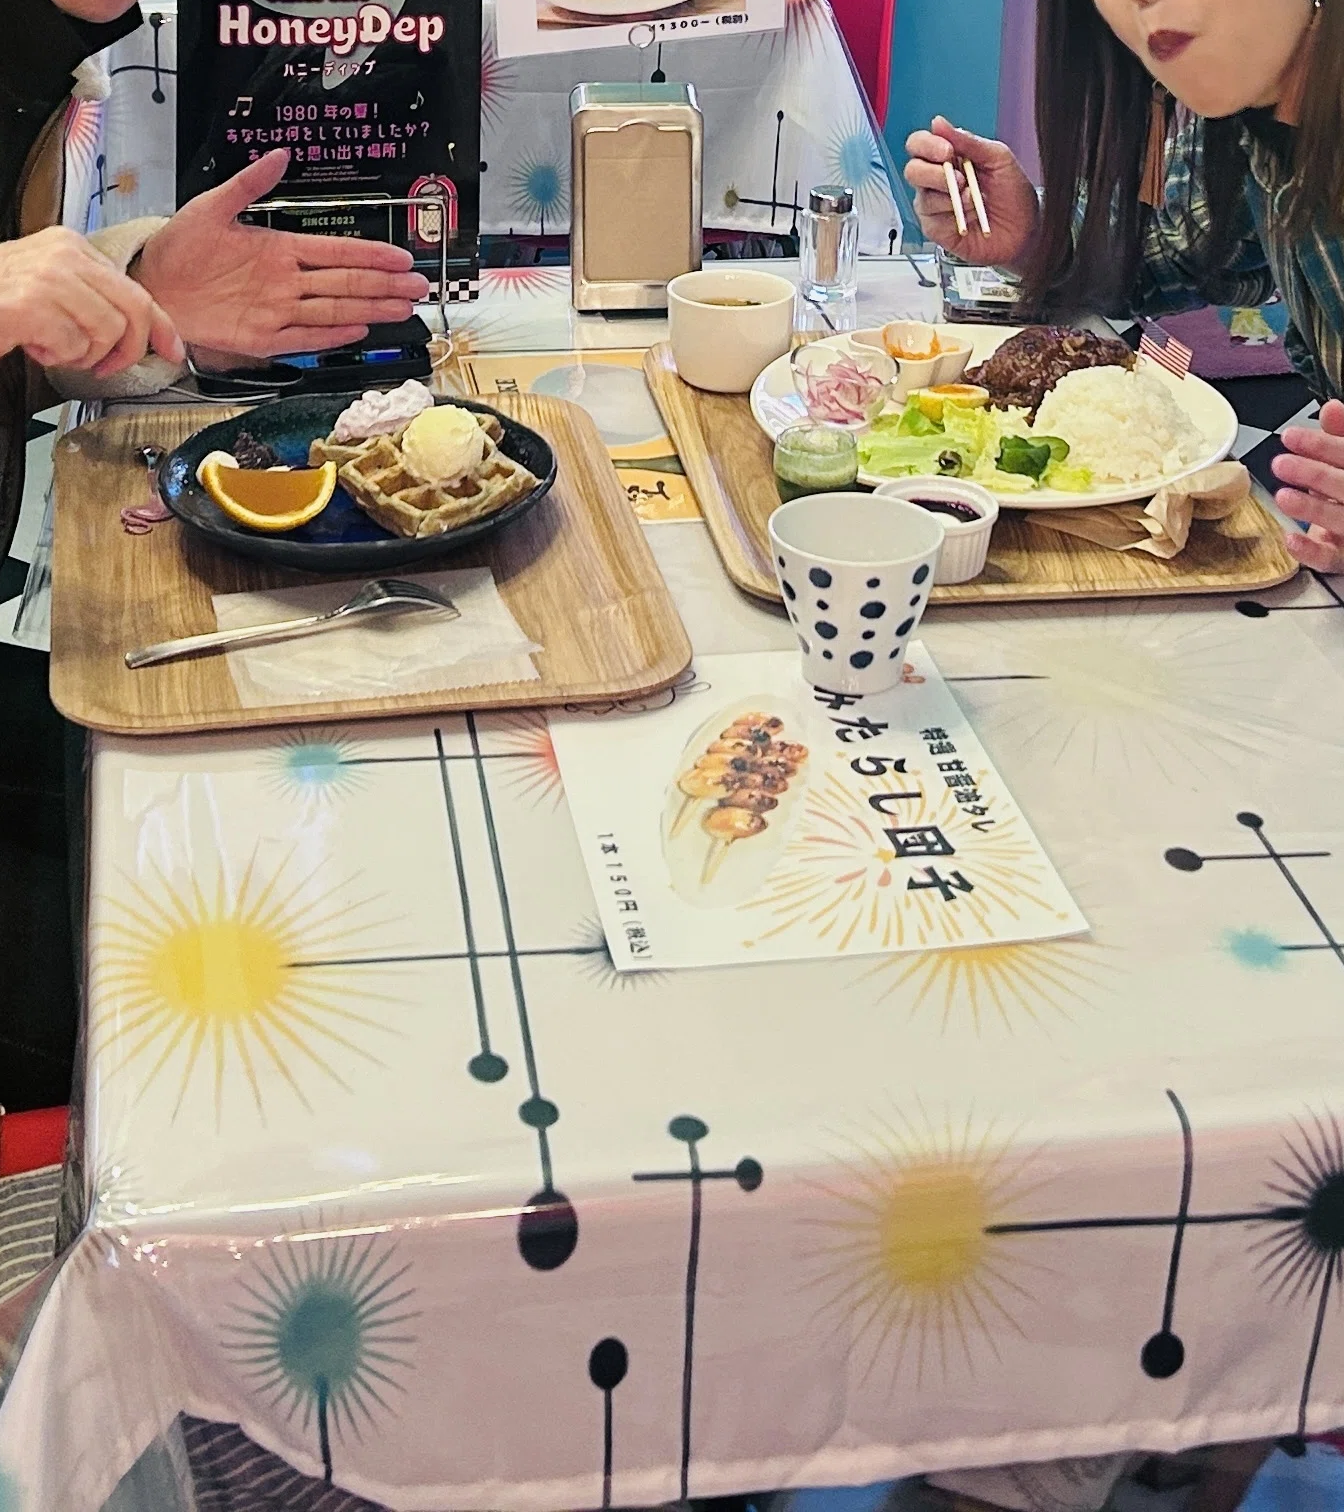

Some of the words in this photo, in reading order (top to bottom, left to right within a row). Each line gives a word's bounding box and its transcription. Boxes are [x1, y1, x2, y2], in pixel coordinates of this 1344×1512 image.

[217, 3, 445, 56] HoneyDep
[283, 59, 377, 78] ハニーディップ
[275, 104, 318, 122] 1980
[301, 216, 329, 227] SINCE
[330, 215, 356, 226] 2023
